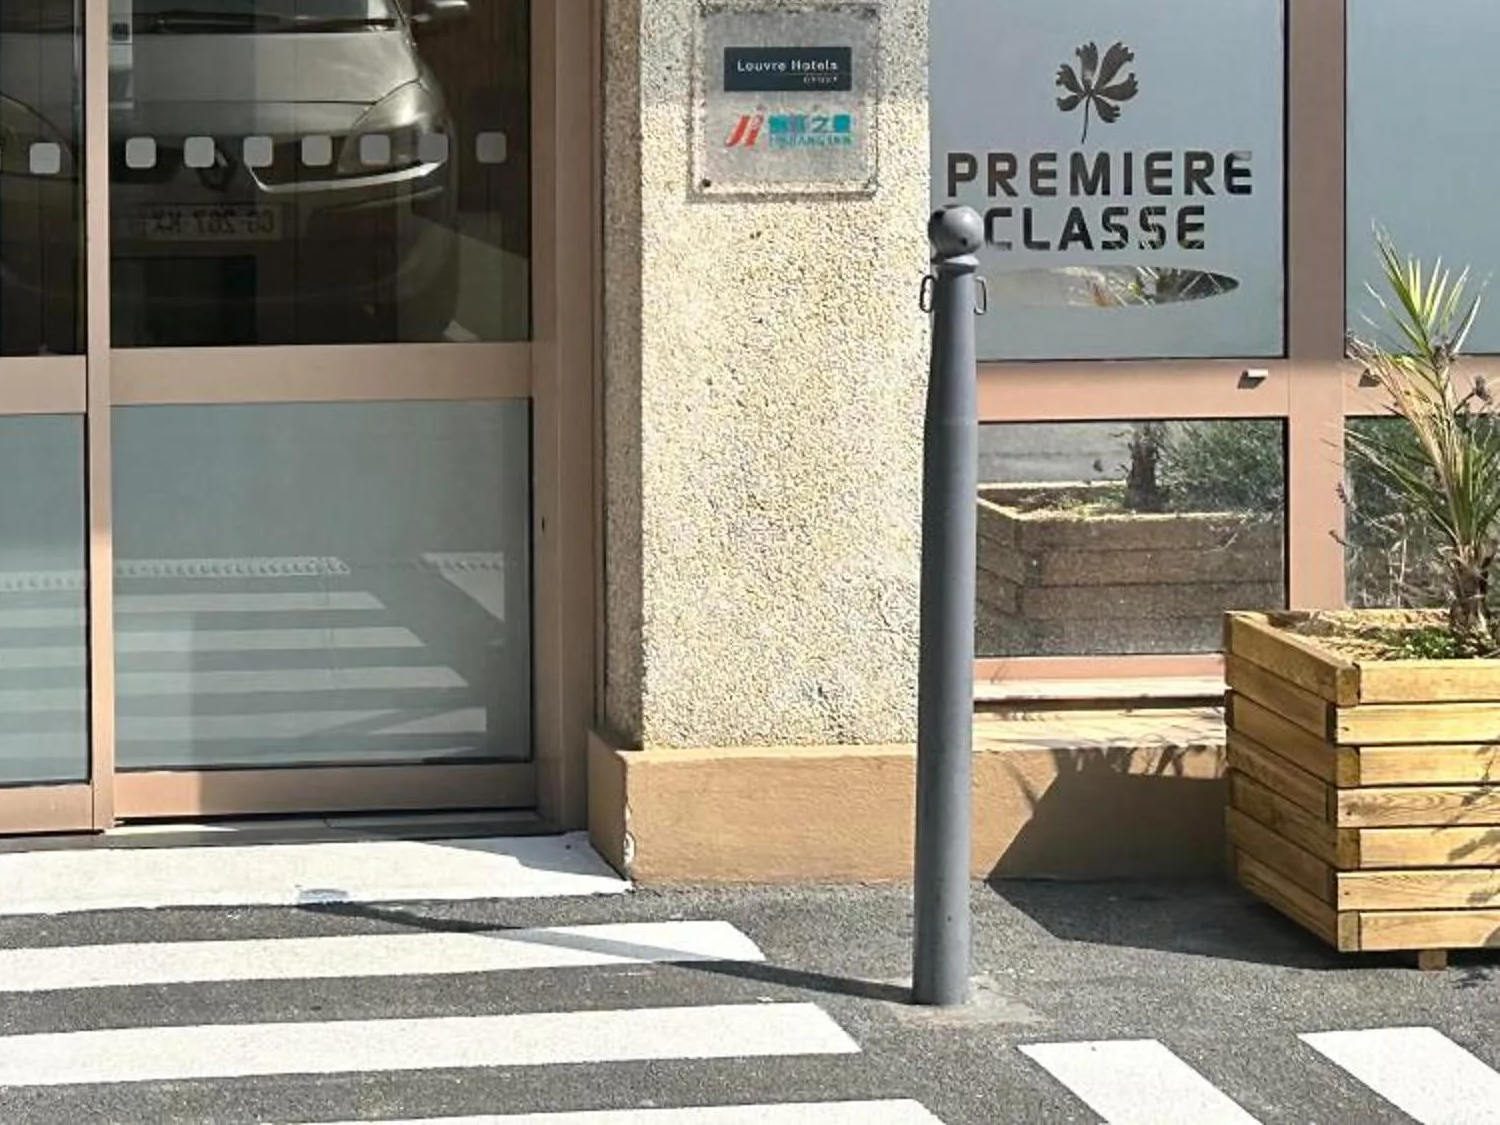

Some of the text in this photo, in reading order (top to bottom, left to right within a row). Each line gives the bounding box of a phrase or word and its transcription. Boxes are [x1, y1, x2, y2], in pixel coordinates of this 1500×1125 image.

[737, 59, 838, 73] Louvre Hotels
[947, 150, 1253, 198] PREMIERE
[983, 205, 1206, 252] CLASSE
